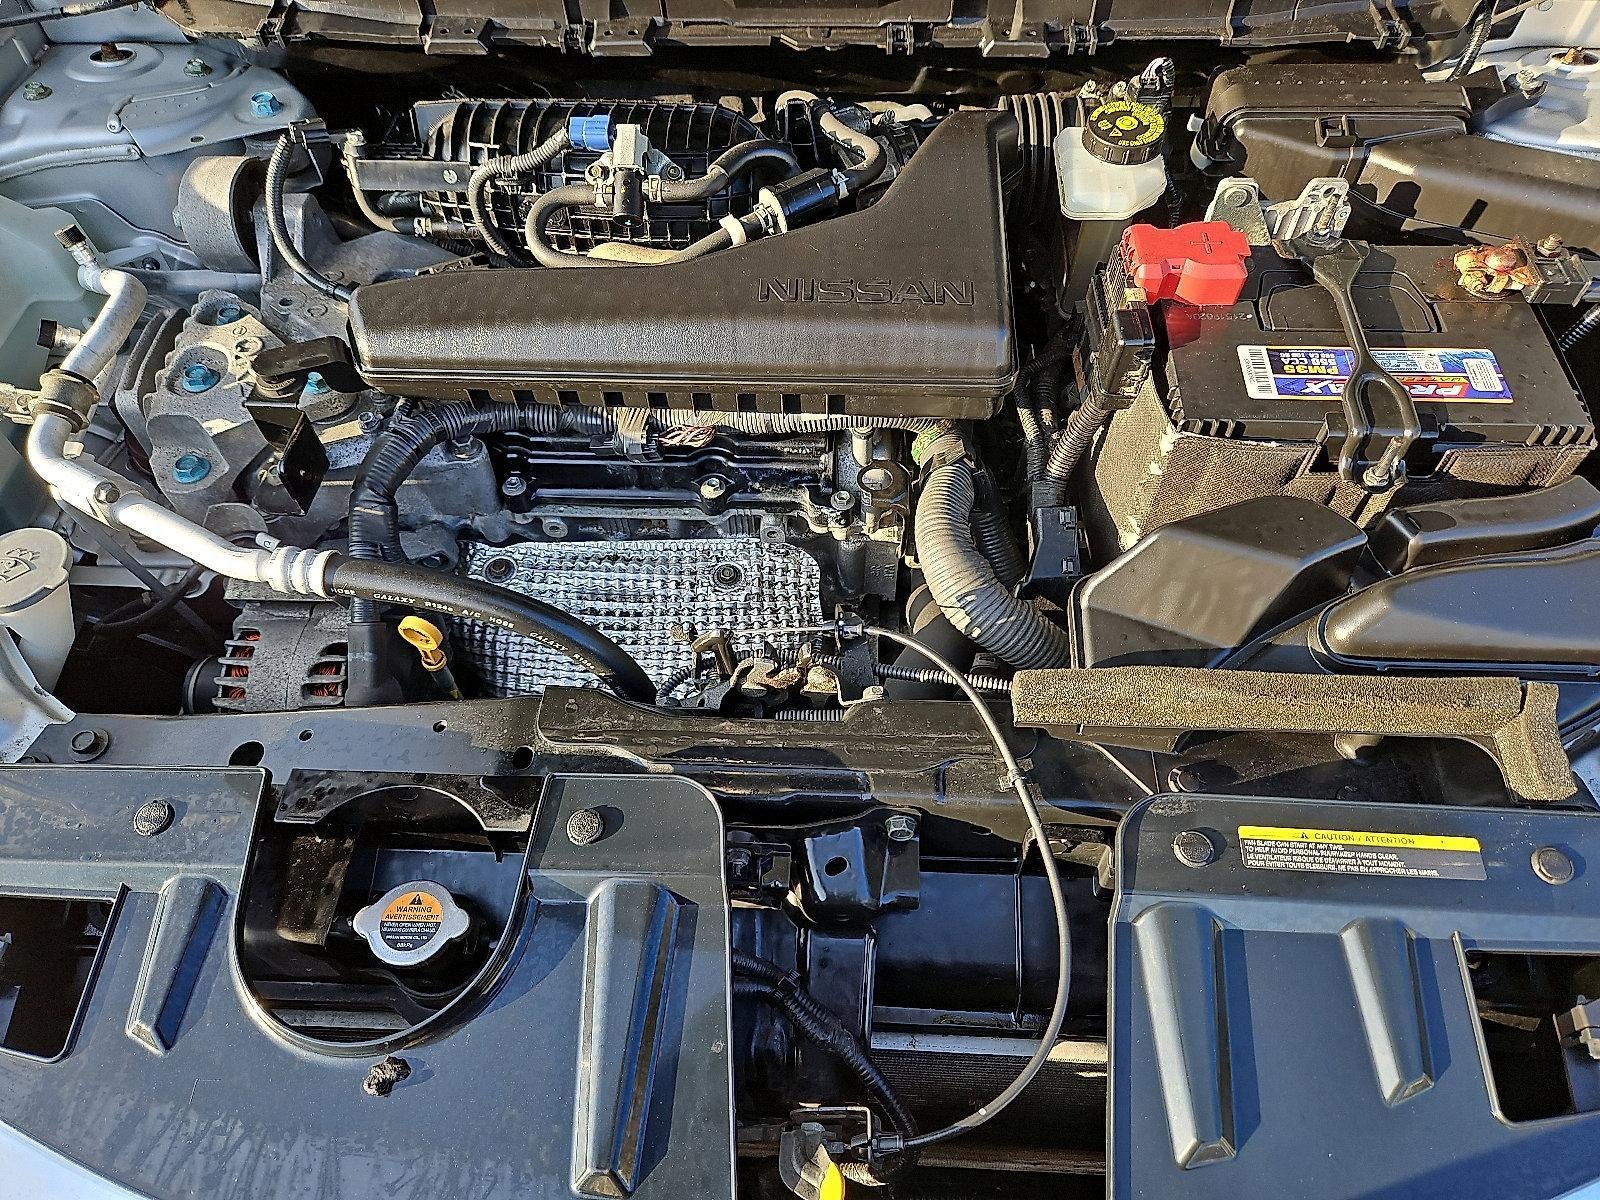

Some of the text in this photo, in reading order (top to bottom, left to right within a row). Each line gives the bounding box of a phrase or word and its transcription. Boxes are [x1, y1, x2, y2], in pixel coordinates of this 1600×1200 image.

[757, 277, 975, 306] NISSAN
[1281, 357, 1306, 365] CCA
[1283, 364, 1339, 375] PM35
[330, 587, 357, 596] HOSE
[373, 592, 416, 605] GALAXY
[461, 609, 482, 618] A/C
[488, 616, 515, 629] HOSE
[529, 631, 569, 651] GALAXY
[1314, 832, 1355, 842] CAUTION
[1365, 836, 1415, 845] ATTENTION
[1288, 848, 1320, 856] PERSONAL
[384, 913, 440, 921] AVERTISSEMENT
